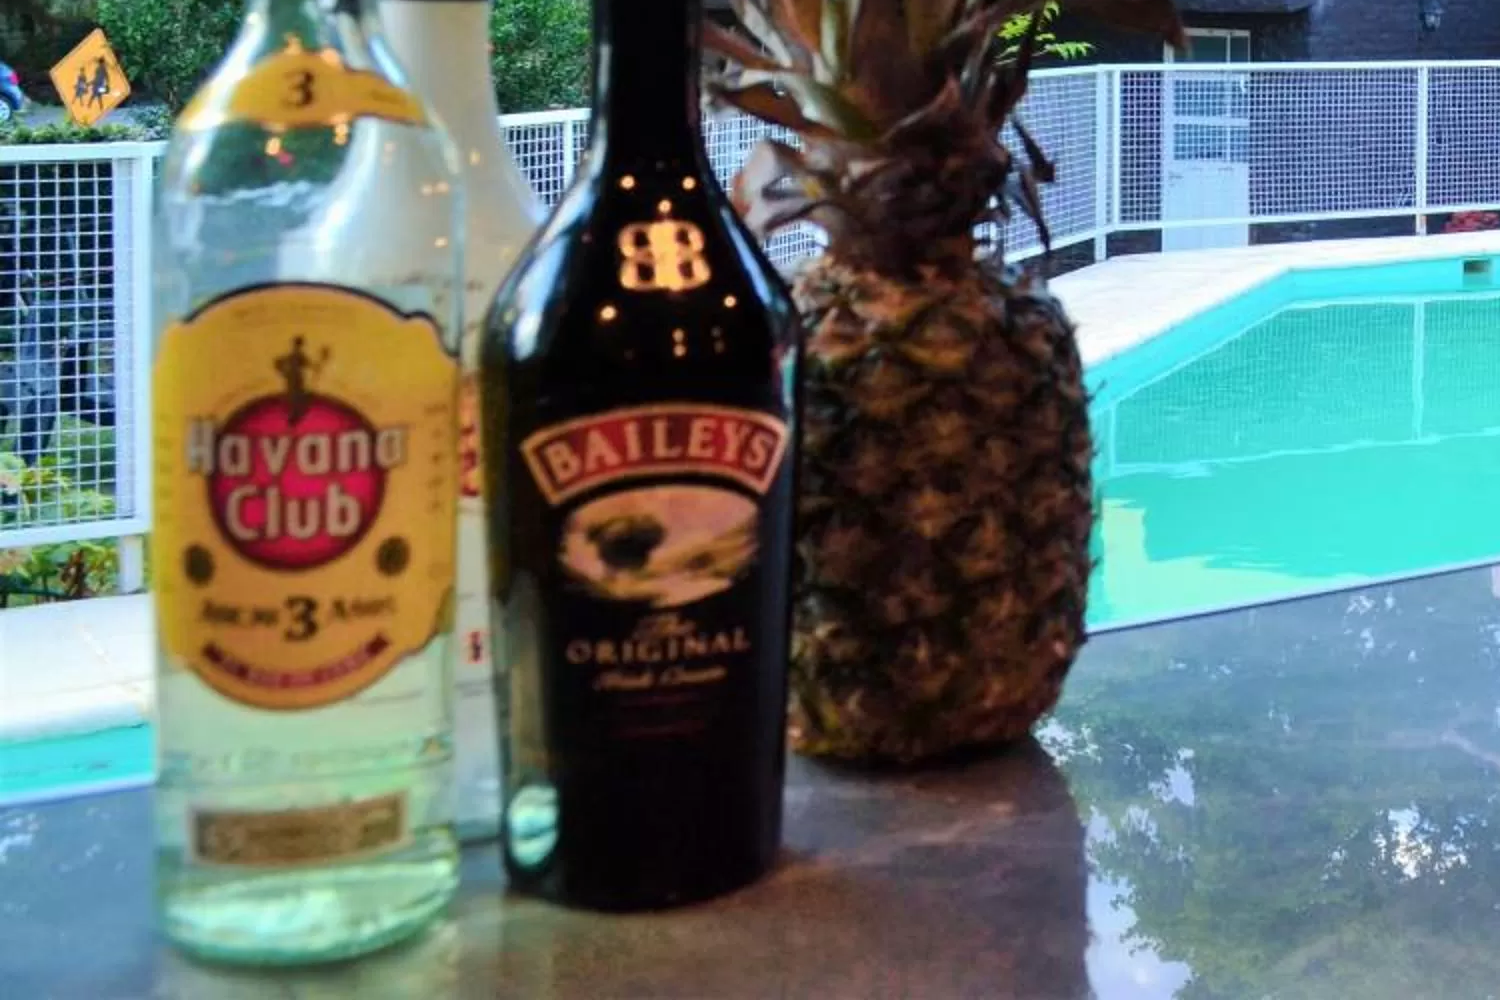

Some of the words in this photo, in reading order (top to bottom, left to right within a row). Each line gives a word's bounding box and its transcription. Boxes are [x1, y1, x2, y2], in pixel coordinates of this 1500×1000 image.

[284, 70, 315, 107] 3
[184, 417, 408, 476] Havana
[543, 417, 770, 485] BAILEYS
[225, 482, 361, 541] Club
[284, 595, 319, 642] 3
[564, 625, 751, 665] ORIGINAL
